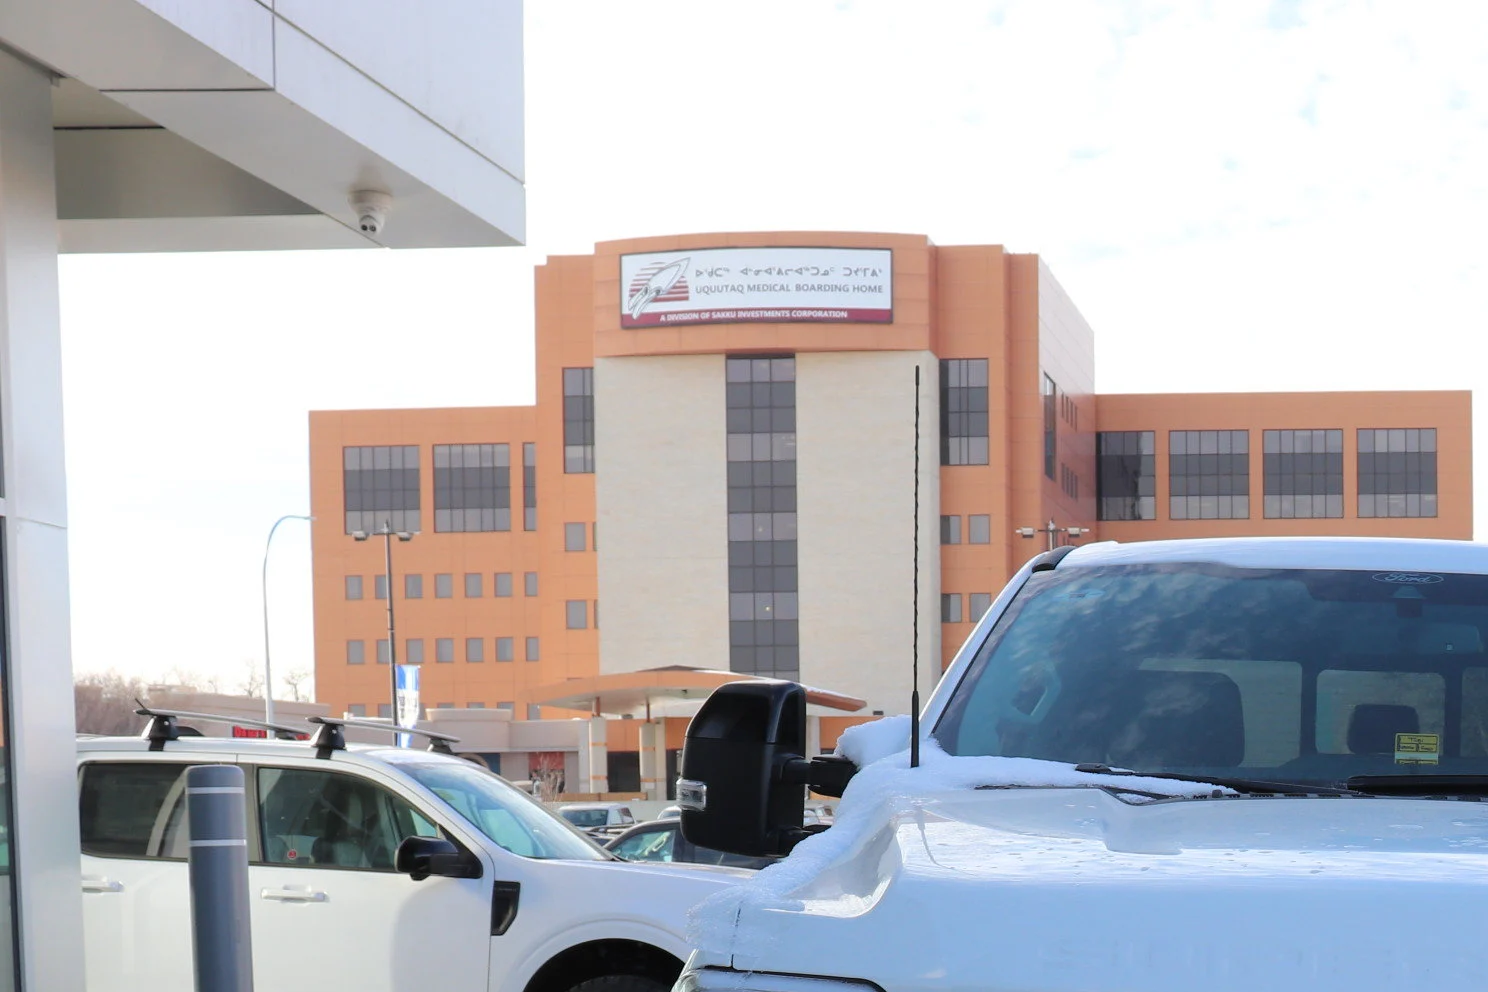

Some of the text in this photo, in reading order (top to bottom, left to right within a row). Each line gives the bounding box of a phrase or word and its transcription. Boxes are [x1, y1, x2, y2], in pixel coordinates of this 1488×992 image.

[695, 284, 883, 295] UQUUTAQ MEDICAL BOARDING HOME
[667, 312, 699, 321] DIVISION
[700, 312, 710, 320] OF
[711, 311, 736, 319] SAKKU
[737, 310, 790, 318] INVESTMENTS
[791, 310, 848, 318] CORPORATION
[1384, 573, 1432, 583] Ford
